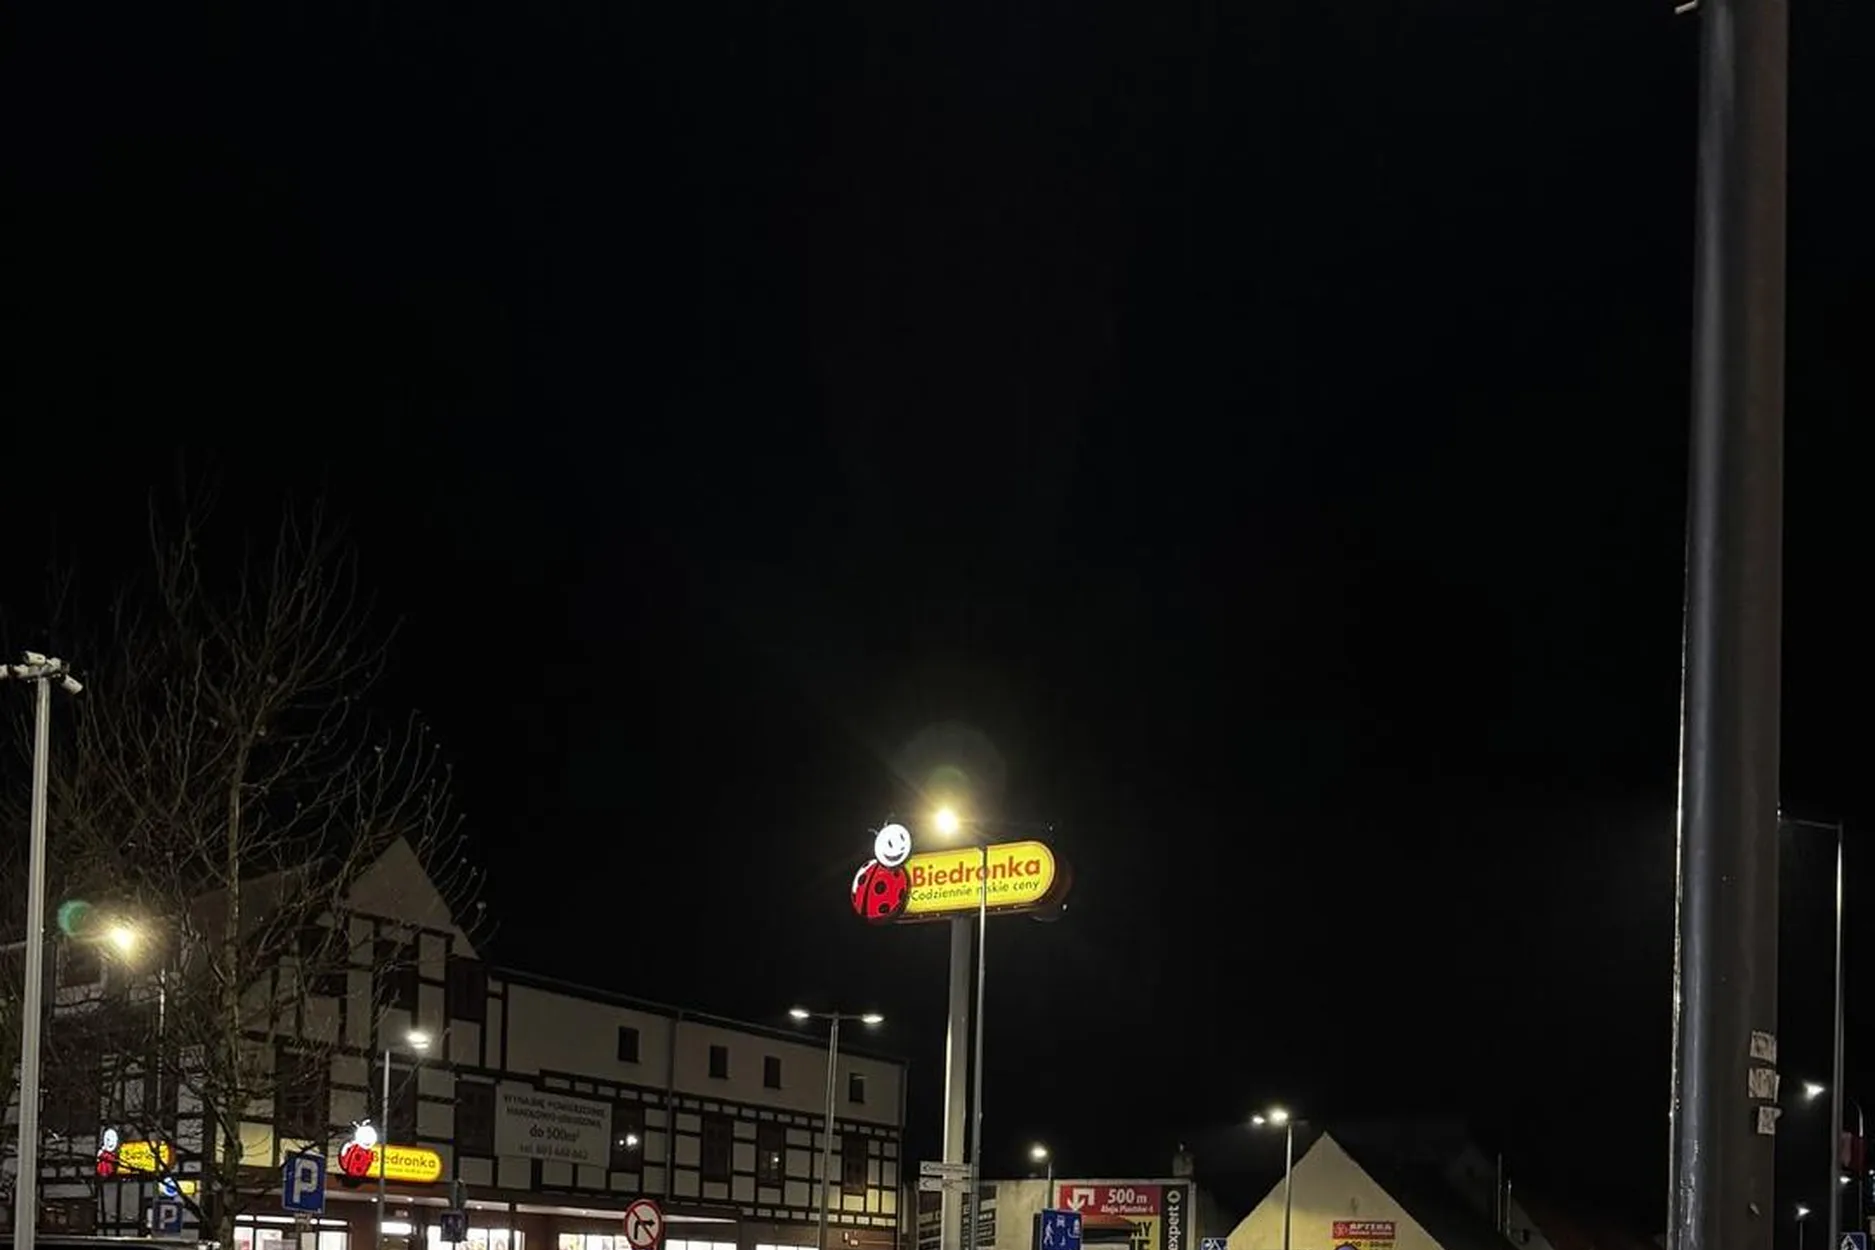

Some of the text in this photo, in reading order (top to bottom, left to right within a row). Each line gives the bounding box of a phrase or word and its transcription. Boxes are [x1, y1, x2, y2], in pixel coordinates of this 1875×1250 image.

[911, 856, 1040, 887] Biedronka
[976, 883, 1009, 897] nskie
[292, 1158, 319, 1203] P
[1108, 1188, 1147, 1204] 500 m
[159, 1203, 178, 1230] P
